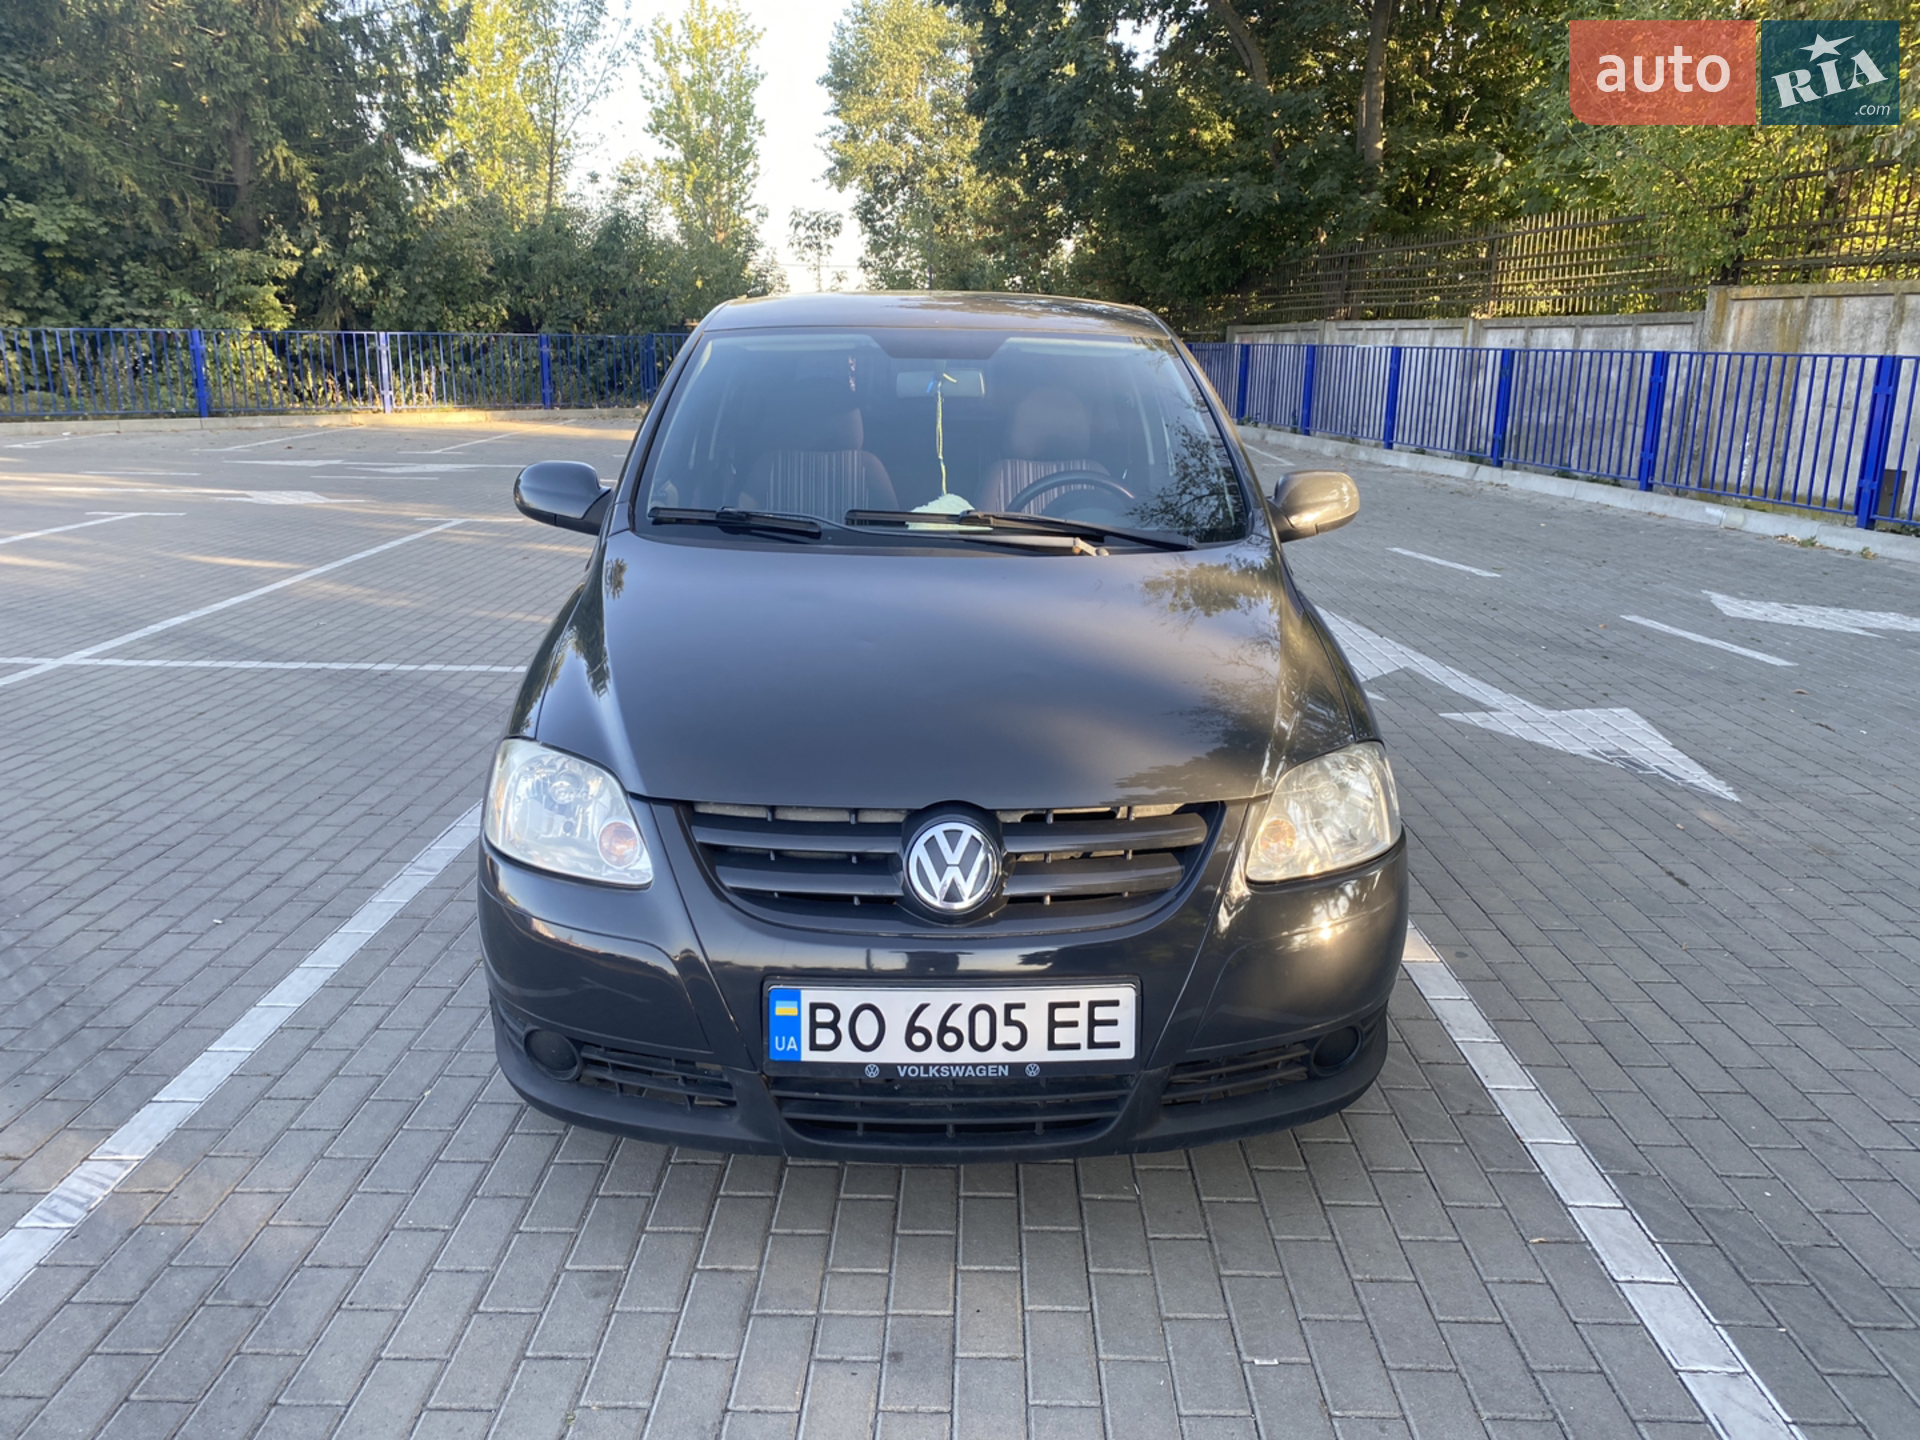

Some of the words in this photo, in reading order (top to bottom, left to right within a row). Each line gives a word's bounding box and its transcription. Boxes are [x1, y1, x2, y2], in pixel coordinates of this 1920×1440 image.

[809, 1002, 886, 1052] BO
[904, 1003, 1028, 1052] 6605
[1047, 1000, 1120, 1051] EE
[775, 1037, 798, 1051] UA
[897, 1065, 1009, 1077] VOLKSWAGEN
